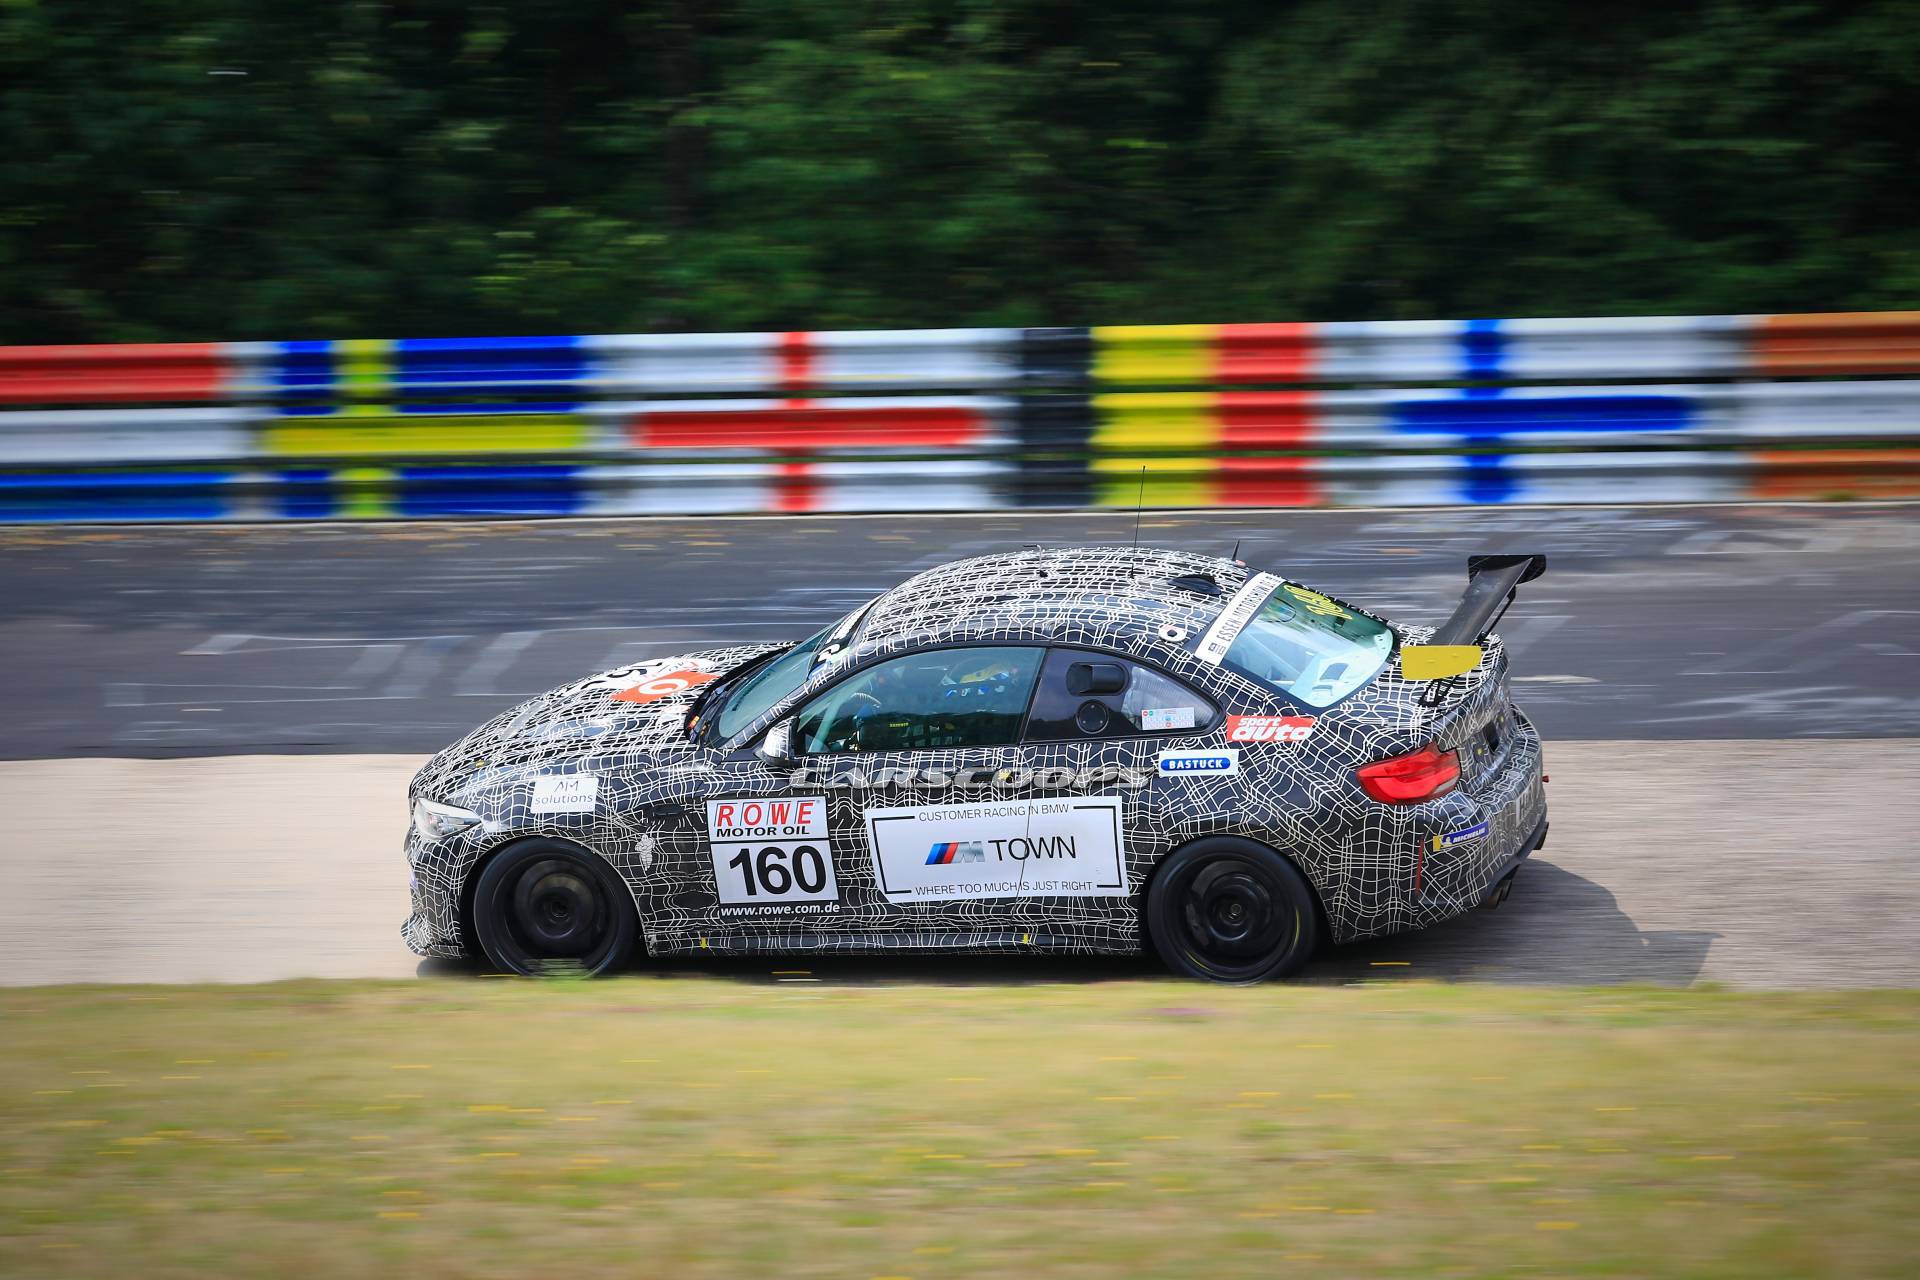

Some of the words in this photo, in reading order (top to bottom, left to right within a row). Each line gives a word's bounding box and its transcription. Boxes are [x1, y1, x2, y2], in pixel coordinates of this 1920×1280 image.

[1238, 717, 1282, 727] sport
[1231, 724, 1314, 741] auto
[1169, 759, 1223, 770] BASTUCK
[535, 793, 593, 805] solutions
[715, 801, 814, 828] ROWE
[919, 808, 981, 821] CUSTOMER
[984, 806, 1026, 818] RACING
[1028, 805, 1039, 815] IN
[1041, 803, 1069, 814] BMW
[716, 826, 777, 838] MOTOR
[782, 825, 810, 836] OIL
[987, 835, 1077, 862] TOWN
[729, 845, 827, 896] 160
[915, 885, 956, 896] WHERE
[957, 883, 982, 894] TOO
[984, 881, 1017, 893] MUCH
[1020, 881, 1030, 891] IS
[1032, 880, 1060, 891] JUST
[1061, 881, 1093, 891] RIGHT
[721, 901, 841, 917] www.rowe.com.de
